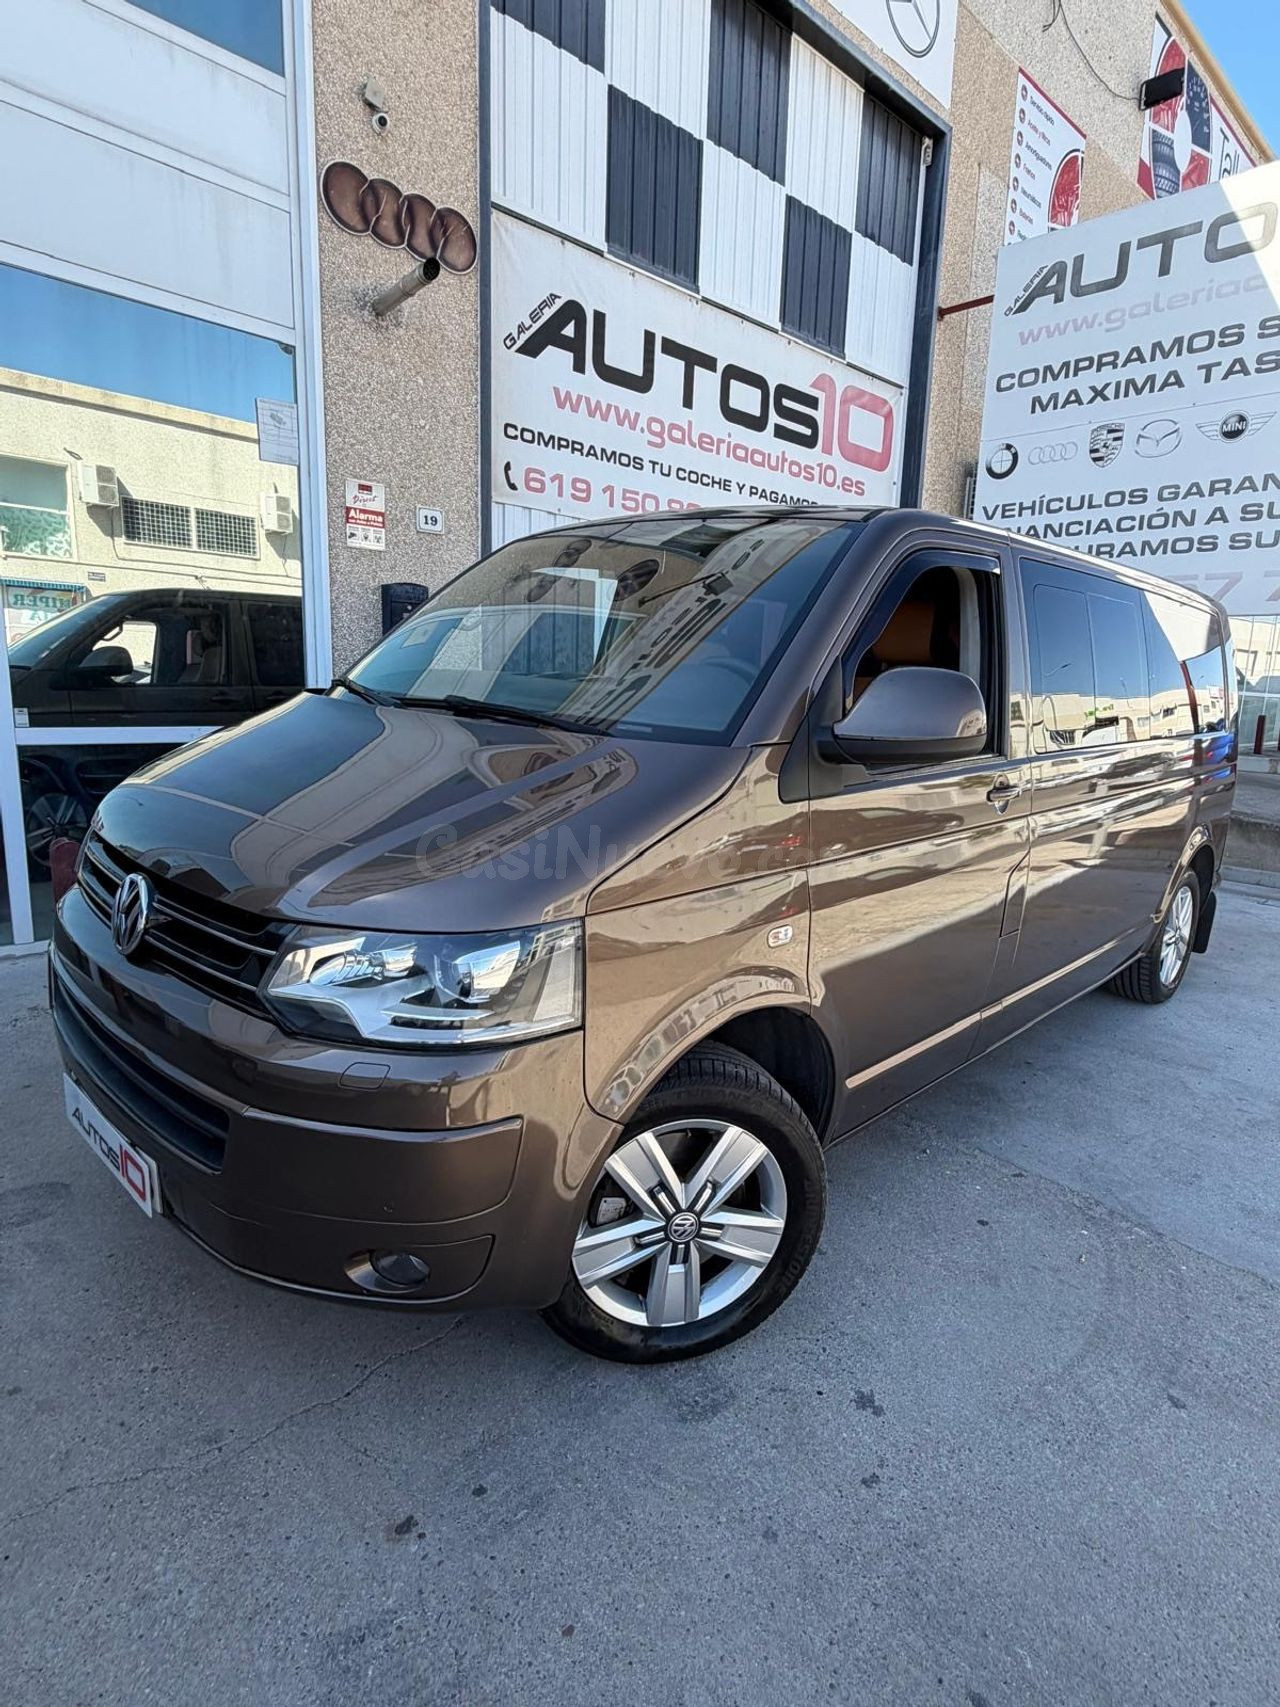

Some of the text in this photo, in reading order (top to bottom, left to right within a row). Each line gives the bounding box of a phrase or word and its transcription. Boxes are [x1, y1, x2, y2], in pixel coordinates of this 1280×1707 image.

[1004, 265, 1048, 316] GALERIA
[503, 293, 562, 351] GALERIA
[995, 323, 1245, 393] COMPRAMOS
[1030, 370, 1186, 414] MAXIMA
[552, 386, 866, 497] www.galeriaautos10.es
[1222, 421, 1247, 434] MINI
[503, 422, 645, 471] COMPRAMOS
[648, 459, 672, 479] TU
[676, 467, 732, 492] COCHE
[736, 482, 746, 495] Y
[523, 466, 592, 503] 619
[602, 484, 660, 514] 150
[982, 487, 1149, 521] VEHÍCULOS
[348, 508, 384, 523] Alarma
[423, 515, 438, 526] 19
[1204, 506, 1229, 525] A
